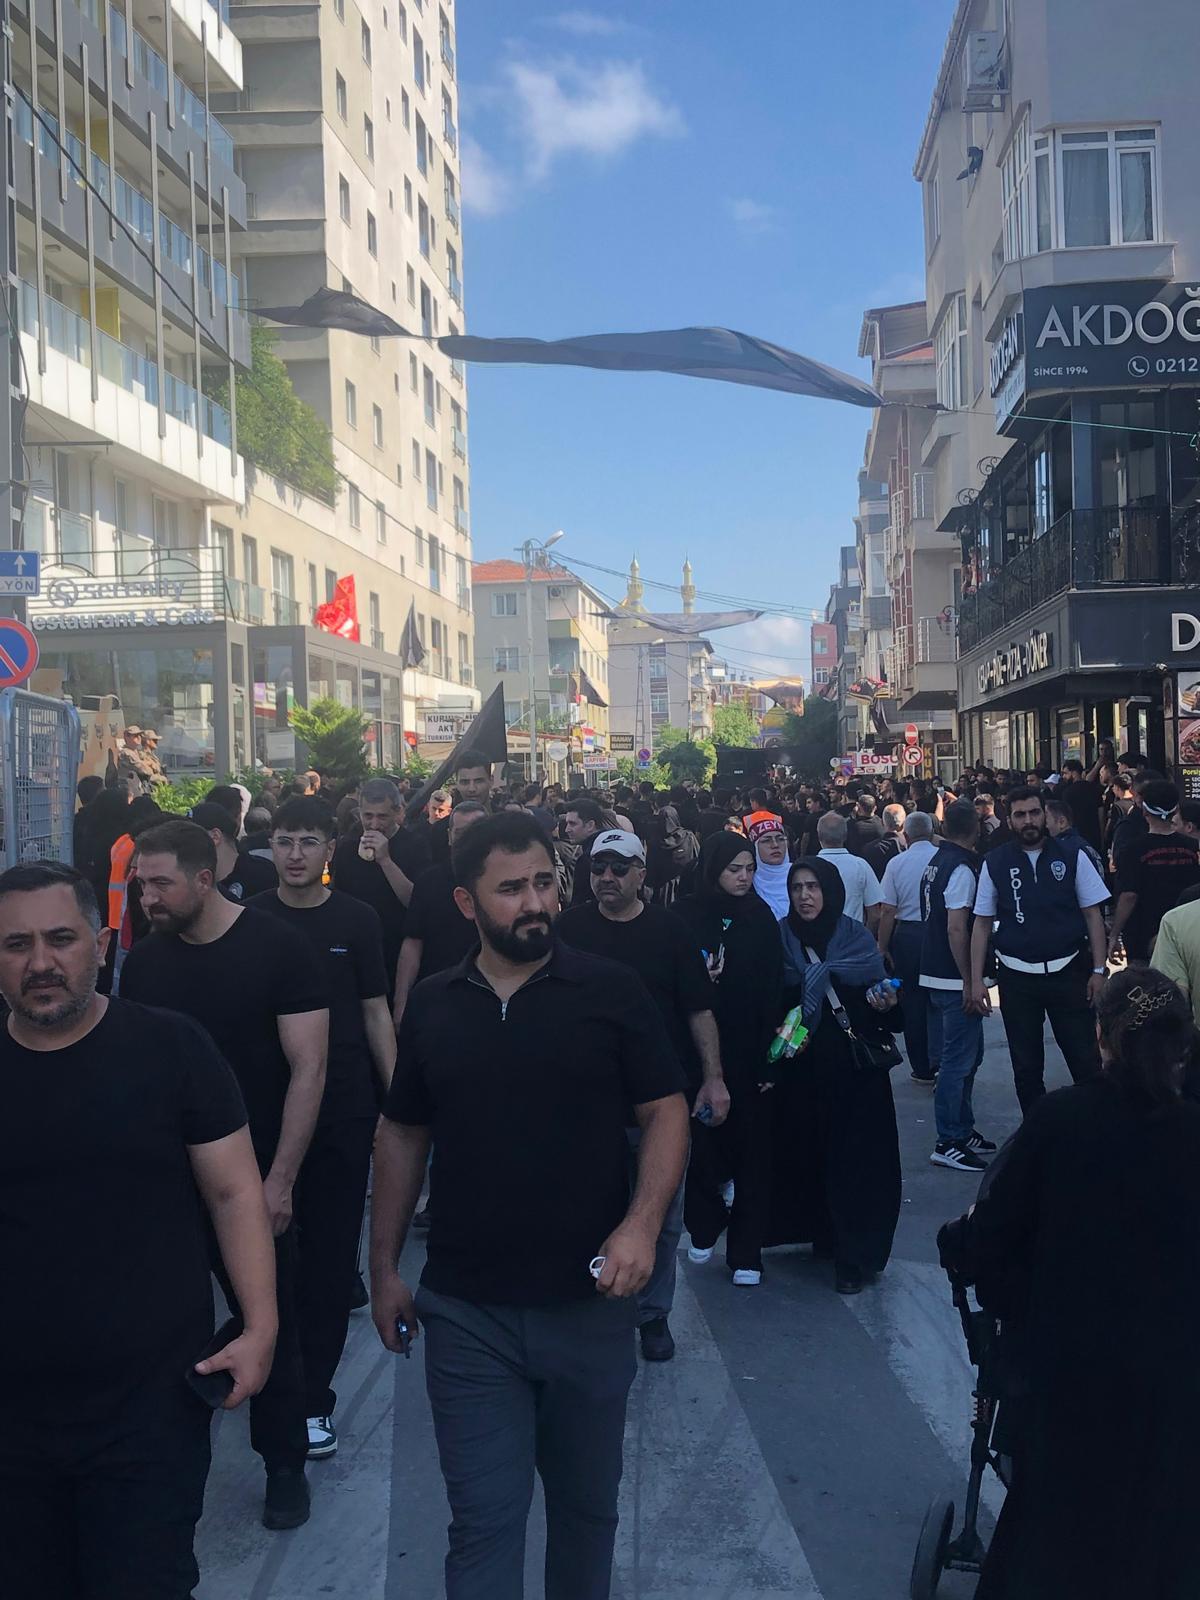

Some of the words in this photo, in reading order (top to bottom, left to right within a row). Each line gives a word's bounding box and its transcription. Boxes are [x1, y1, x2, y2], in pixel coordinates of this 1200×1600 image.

[1066, 366, 1089, 376] 1994
[1155, 357, 1199, 373] 0212
[4, 577, 34, 591] YÖN
[31, 611, 137, 631] estaurant
